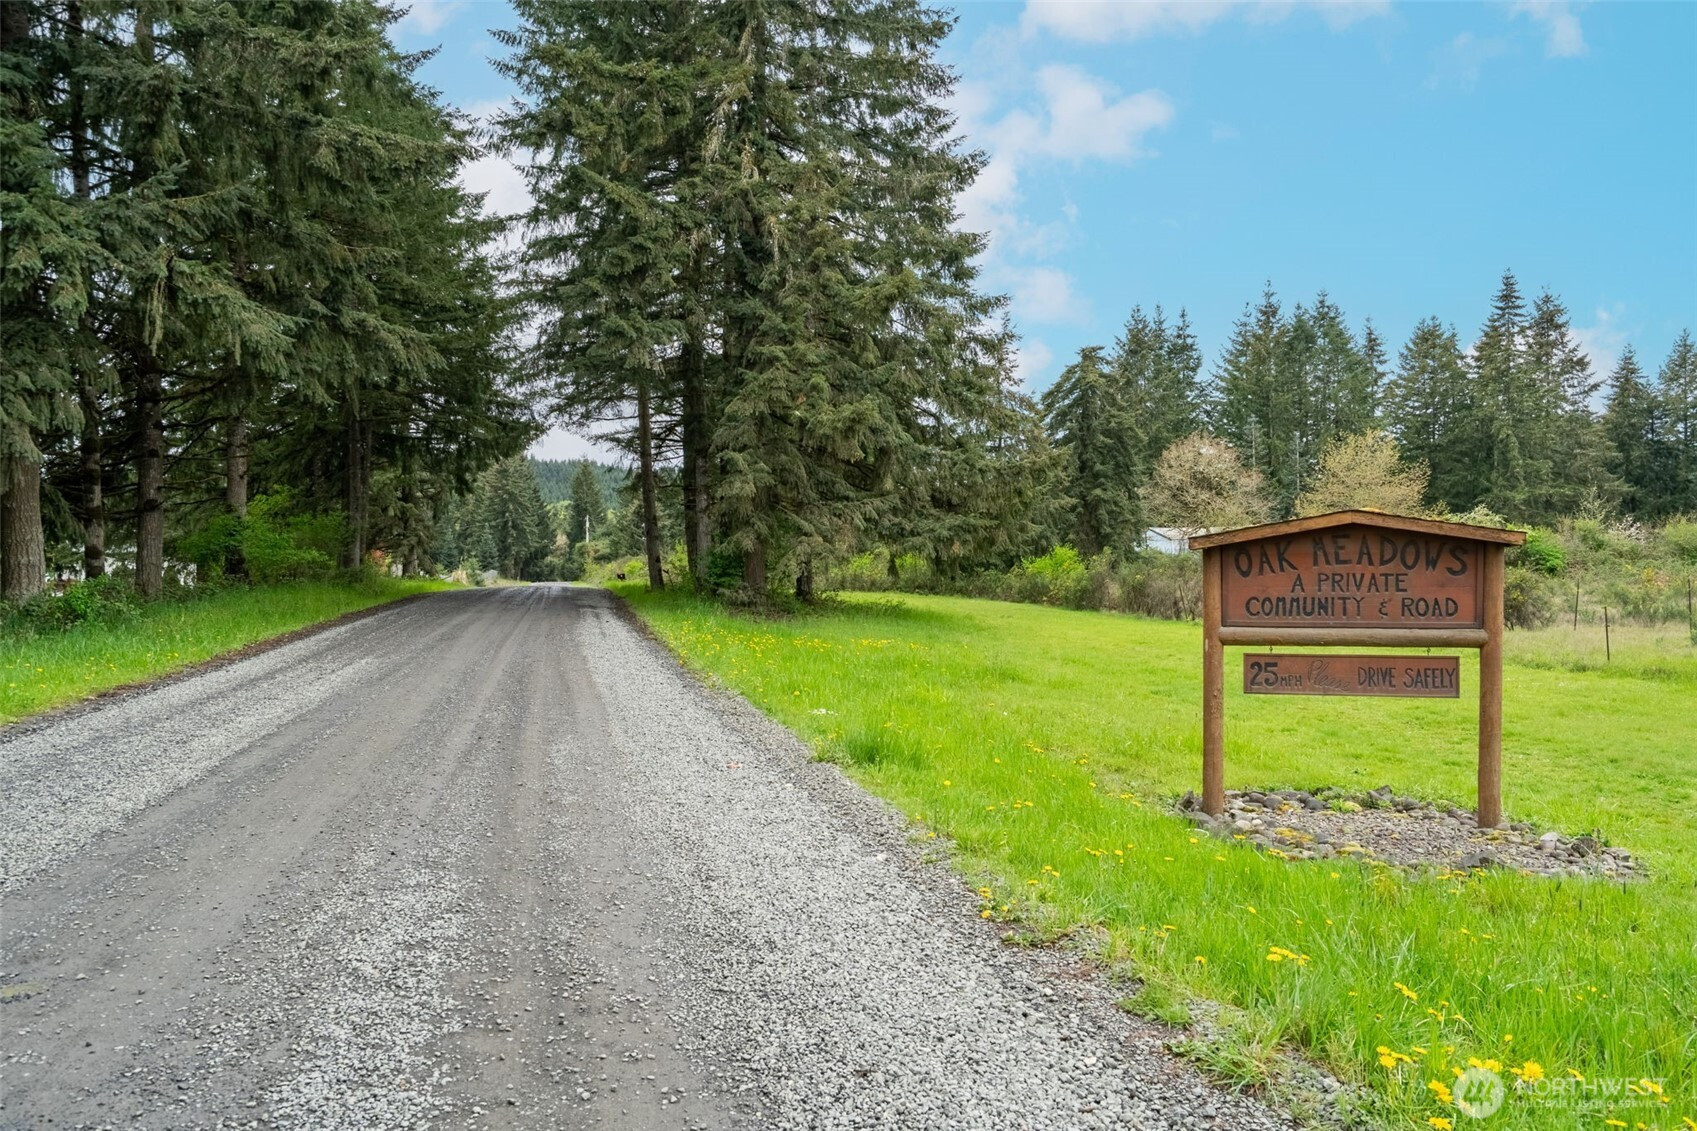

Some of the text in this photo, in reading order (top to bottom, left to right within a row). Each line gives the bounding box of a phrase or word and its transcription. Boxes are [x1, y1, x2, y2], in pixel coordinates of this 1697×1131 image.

[1233, 534, 1468, 578] OAK MEADOWS
[1291, 572, 1408, 593] A PRIVATE
[1245, 596, 1458, 619] COMMUNITY & ROAD
[1357, 666, 1396, 689] DRIVE
[1403, 667, 1456, 690] SAFELY
